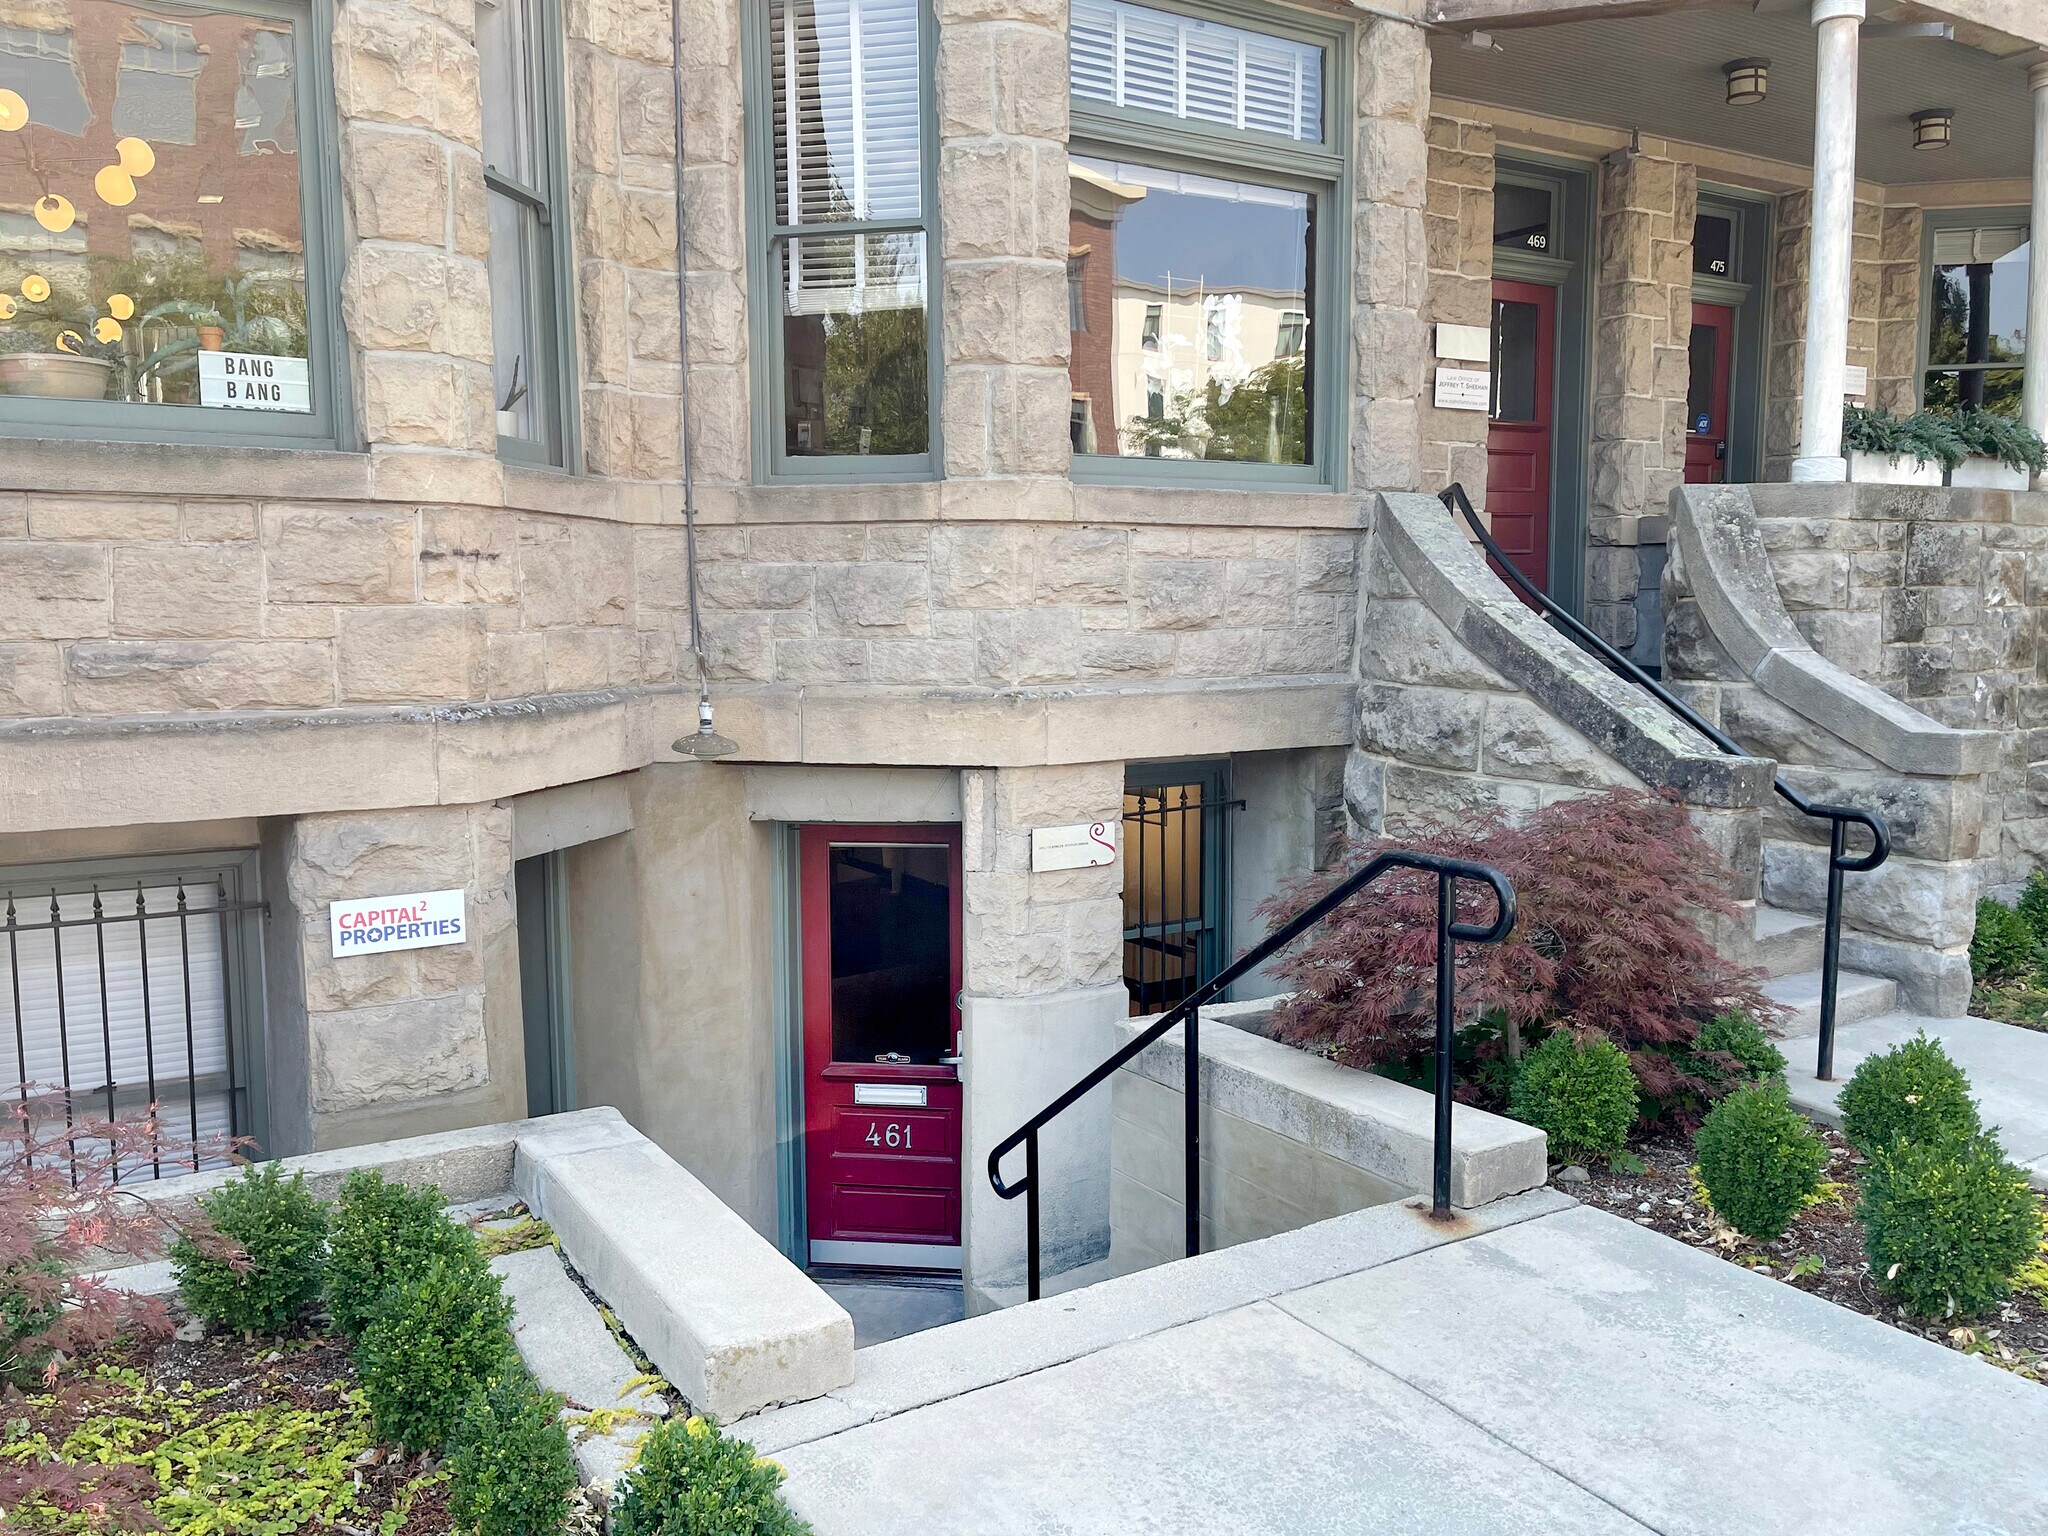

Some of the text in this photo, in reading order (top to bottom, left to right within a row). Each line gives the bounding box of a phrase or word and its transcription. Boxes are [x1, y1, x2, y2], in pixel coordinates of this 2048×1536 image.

[1527, 234, 1546, 249] 469
[1710, 260, 1725, 273] 475
[225, 357, 274, 377] BANG
[340, 918, 461, 946] PROPERTIES
[865, 1122, 912, 1149] 461
